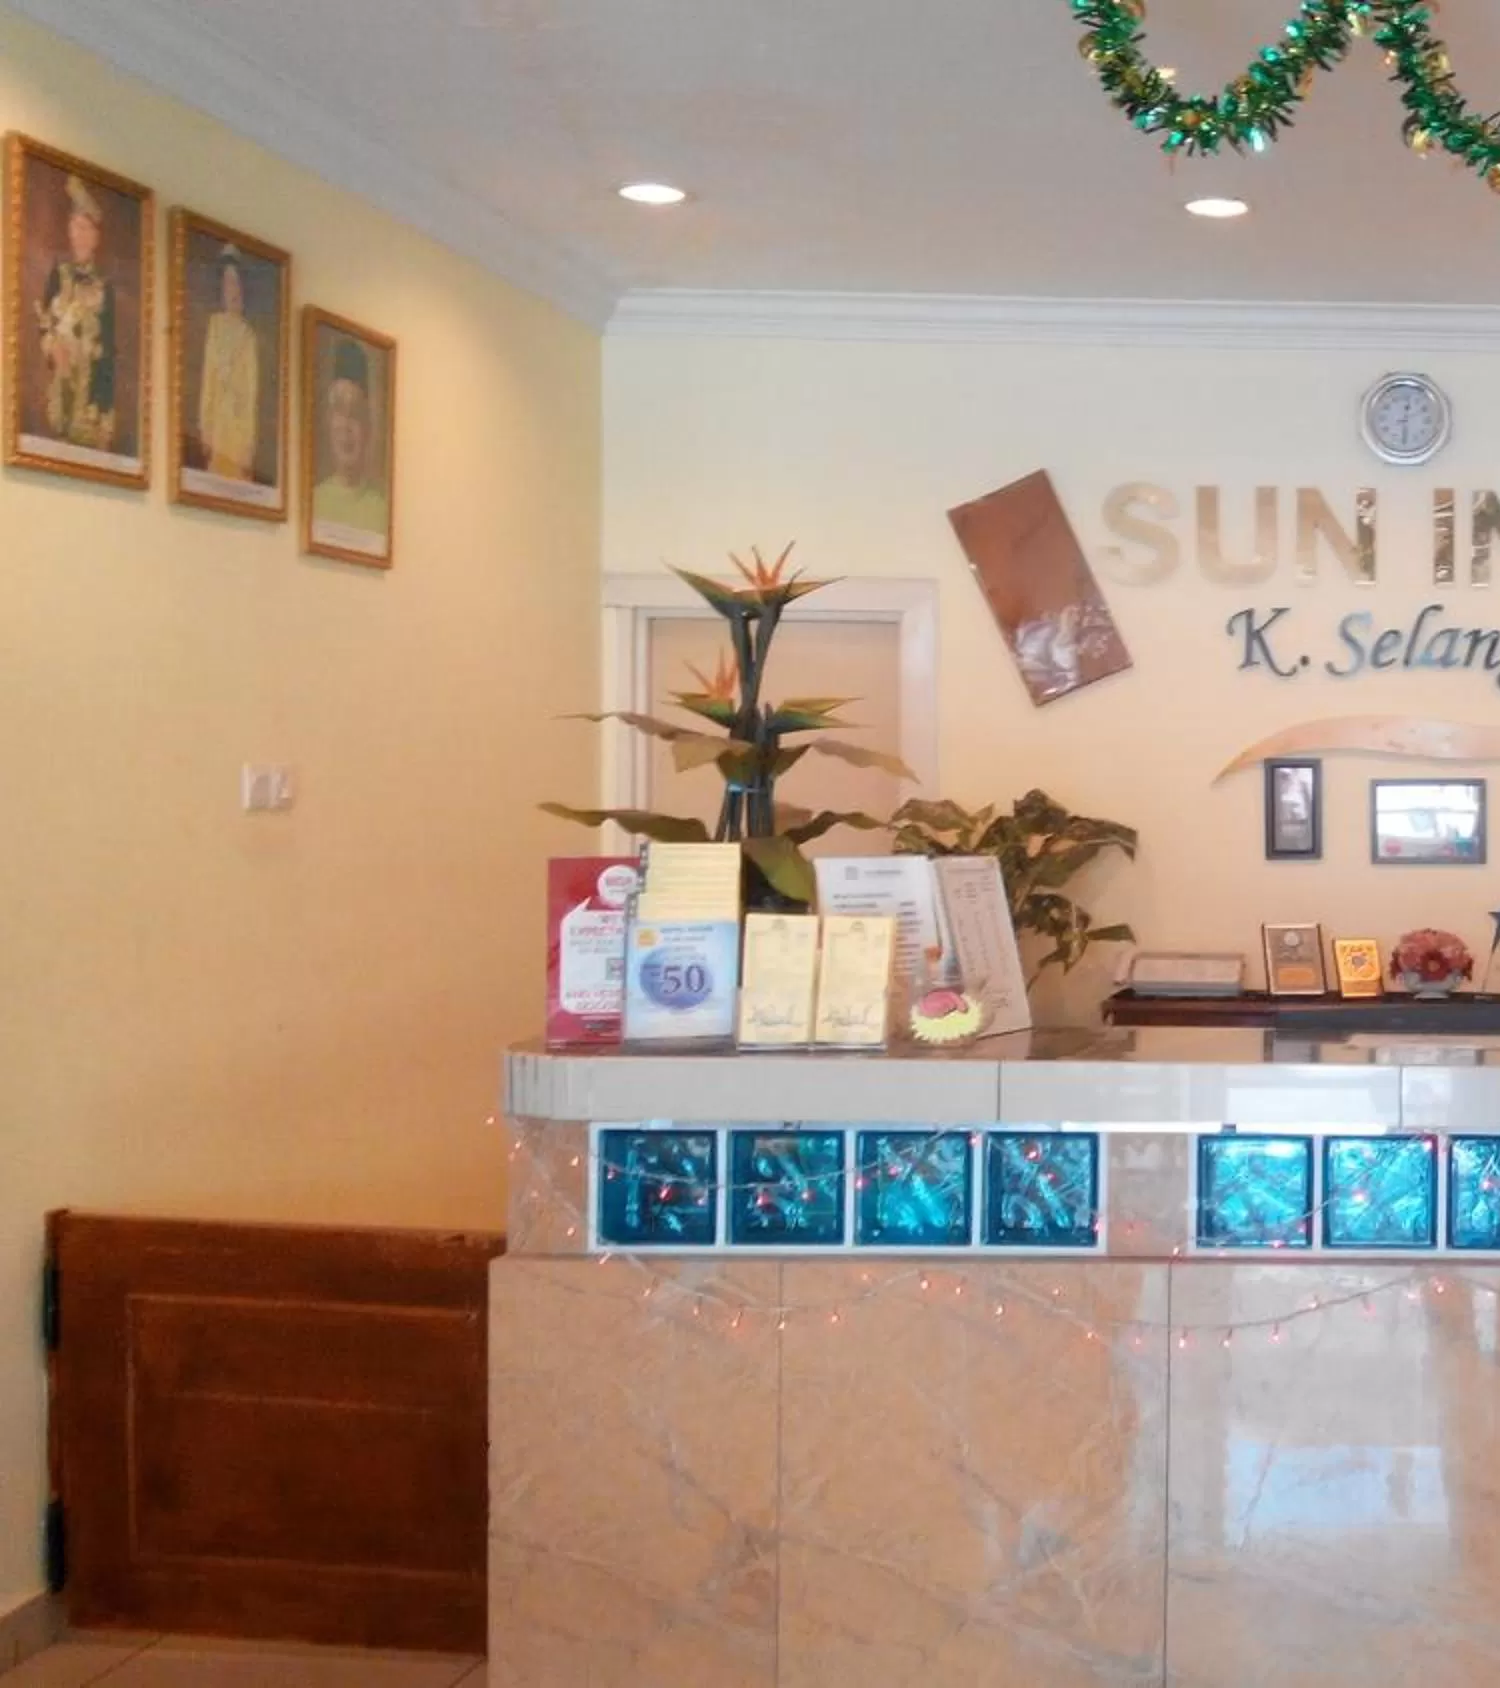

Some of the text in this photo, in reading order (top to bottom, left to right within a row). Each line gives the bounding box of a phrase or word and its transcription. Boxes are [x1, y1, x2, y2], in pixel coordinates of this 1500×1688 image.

[1101, 482, 1376, 587] SUN
[1226, 607, 1310, 677] K.
[663, 964, 705, 994] 50
